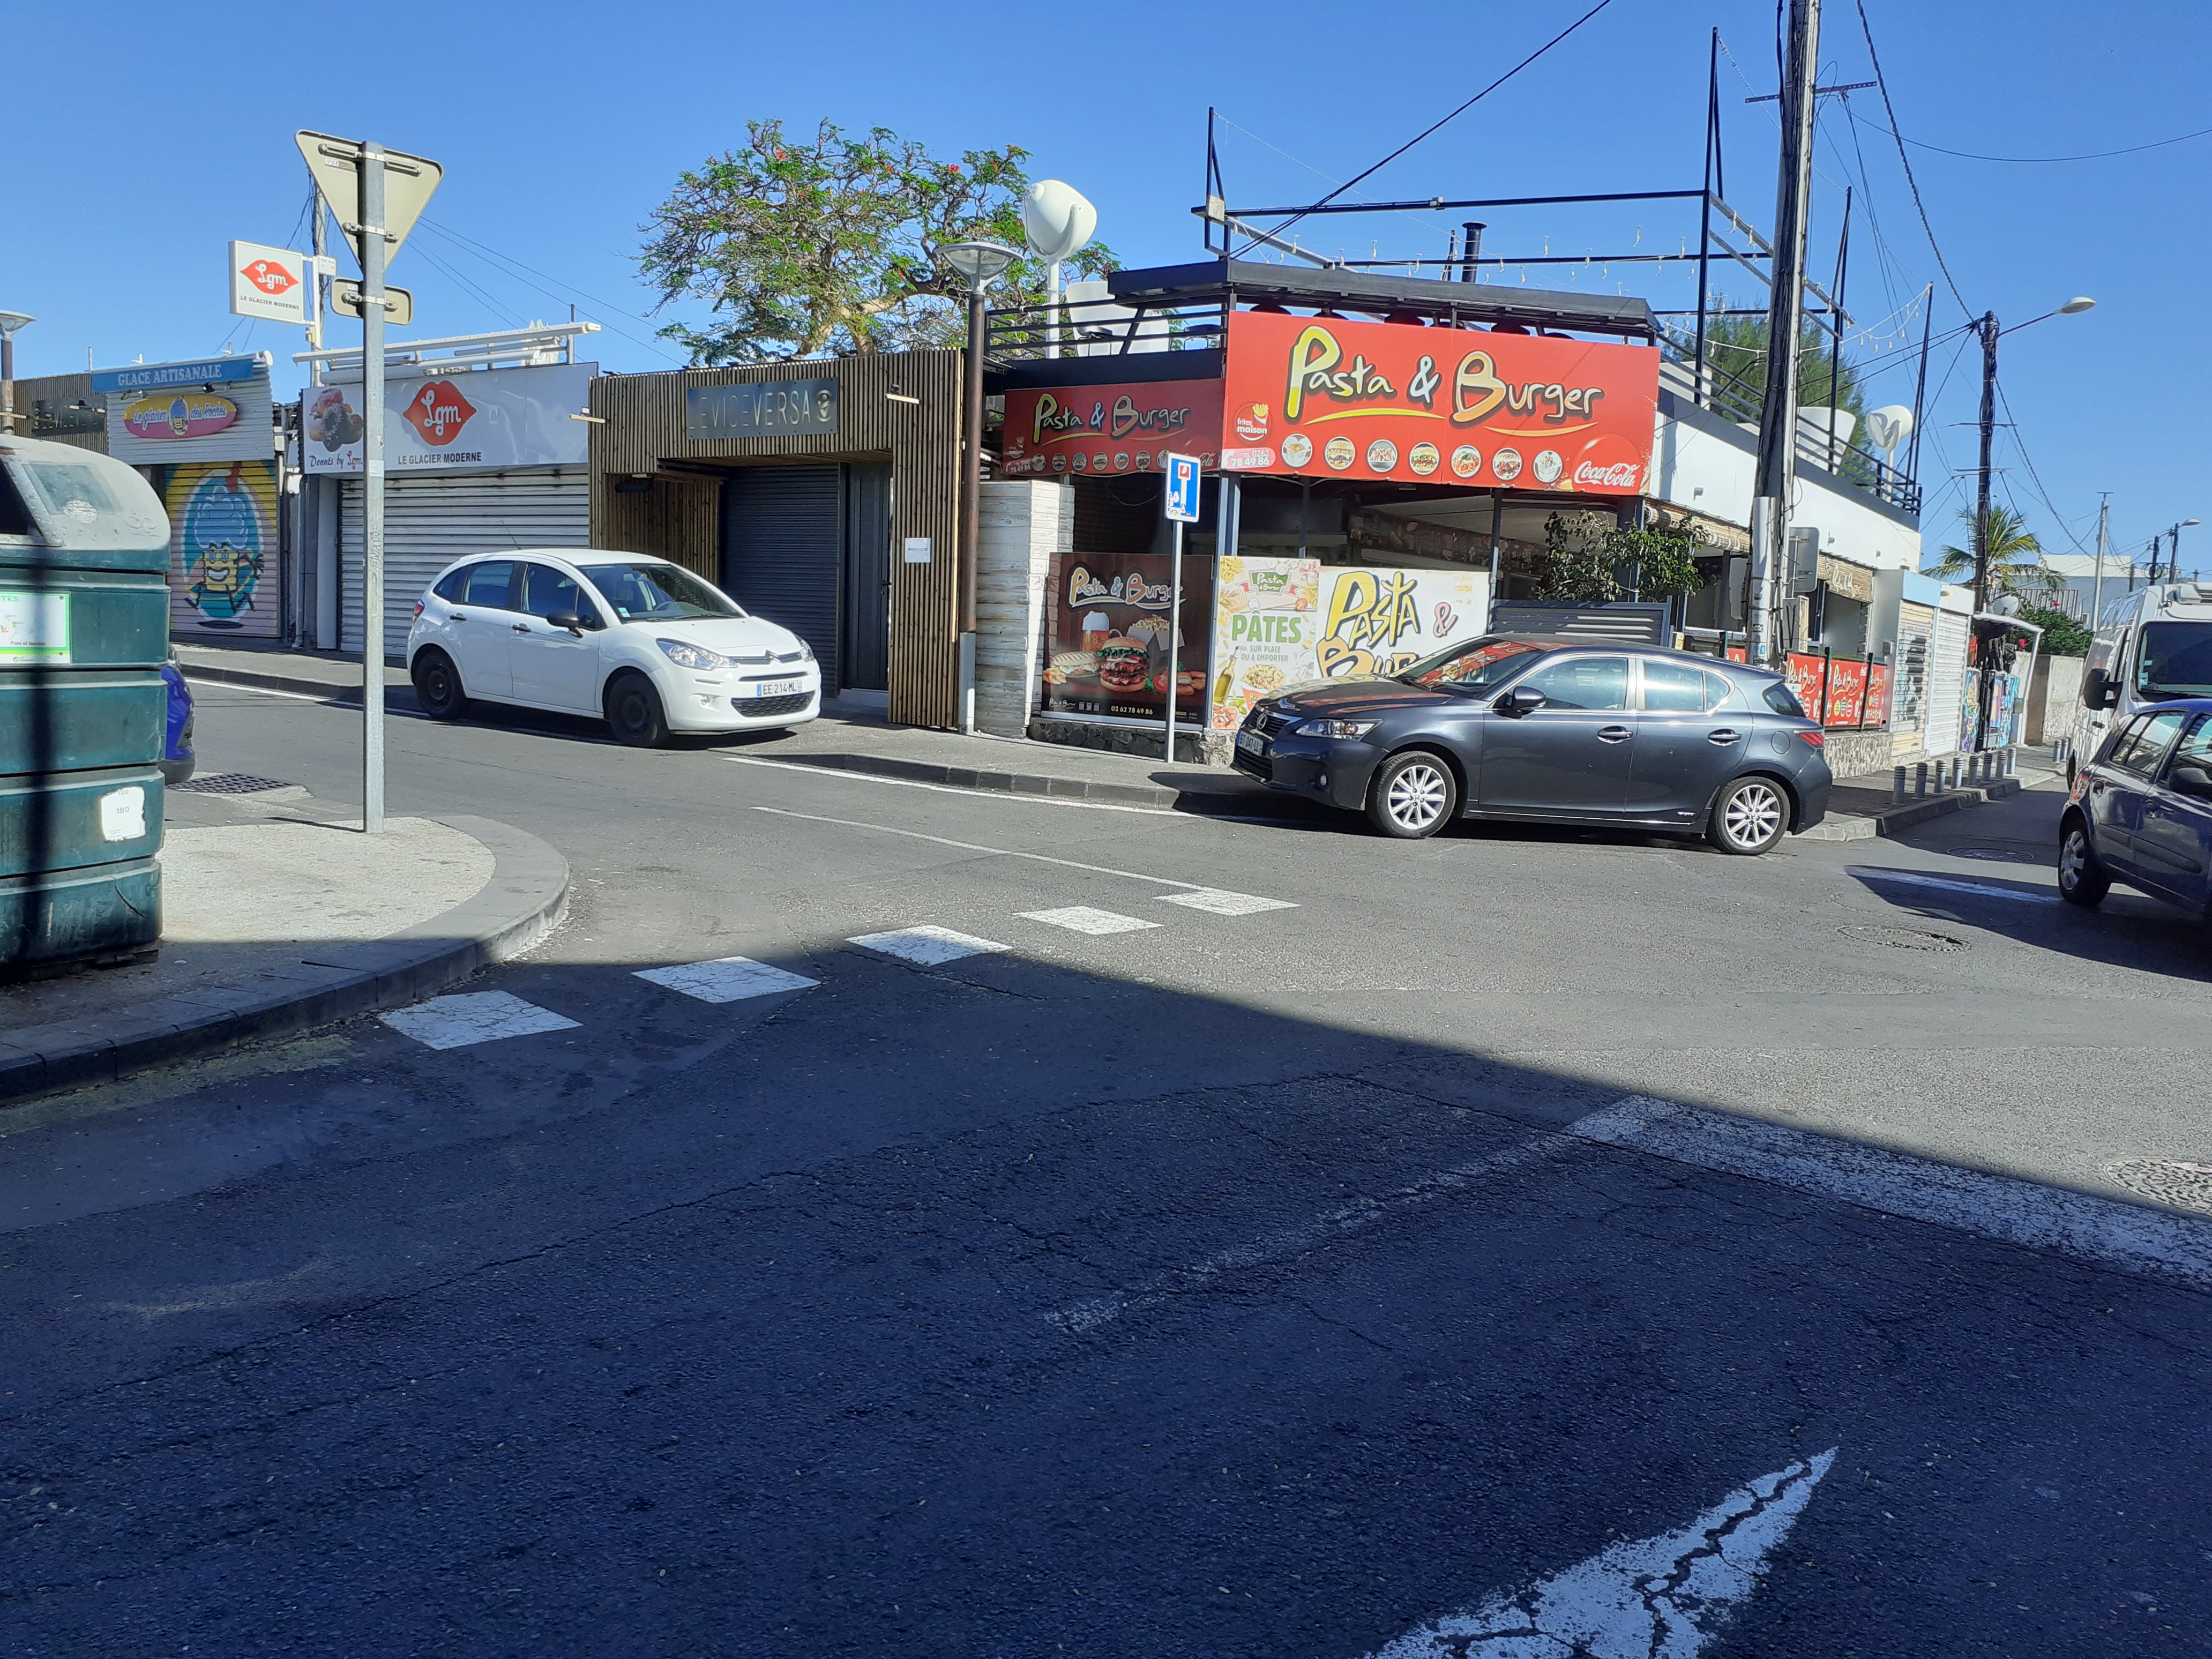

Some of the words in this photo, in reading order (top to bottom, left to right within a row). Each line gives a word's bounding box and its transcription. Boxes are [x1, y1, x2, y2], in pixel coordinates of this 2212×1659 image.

[249, 296, 272, 305] GLACIER
[274, 300, 300, 310] MODERNE
[117, 372, 151, 386] GLACE
[153, 364, 222, 384] ARTISANALE
[1287, 326, 1394, 418] Pasta
[1409, 356, 1439, 403] &
[1453, 350, 1602, 422] Burger
[753, 390, 812, 427] VERSA
[143, 408, 169, 431] glacier
[190, 404, 203, 420] des
[203, 401, 228, 420] Roches
[1033, 393, 1083, 444] Pasta
[1090, 402, 1105, 428] &
[1110, 395, 1190, 437] Burger
[1237, 417, 1252, 425] frites
[1237, 425, 1267, 434] maison
[398, 455, 408, 465] LE
[409, 454, 442, 465] GLACIER
[444, 452, 482, 464] MODERNE
[1252, 450, 1269, 458] 0262
[336, 455, 345, 469] by
[1231, 458, 1243, 467] 78
[1244, 458, 1257, 466] 49
[1258, 457, 1270, 466] 86
[1574, 461, 1641, 487] Coca-Cola
[1070, 567, 1108, 604] Pasta
[1111, 576, 1124, 597] &
[1257, 572, 1284, 585] Pasta
[1231, 609, 1302, 644] PÂTES
[1432, 602, 1458, 638] &
[1250, 645, 1262, 653] SUR
[1257, 654, 1288, 662] EMPORTER
[116, 806, 130, 814] 180
